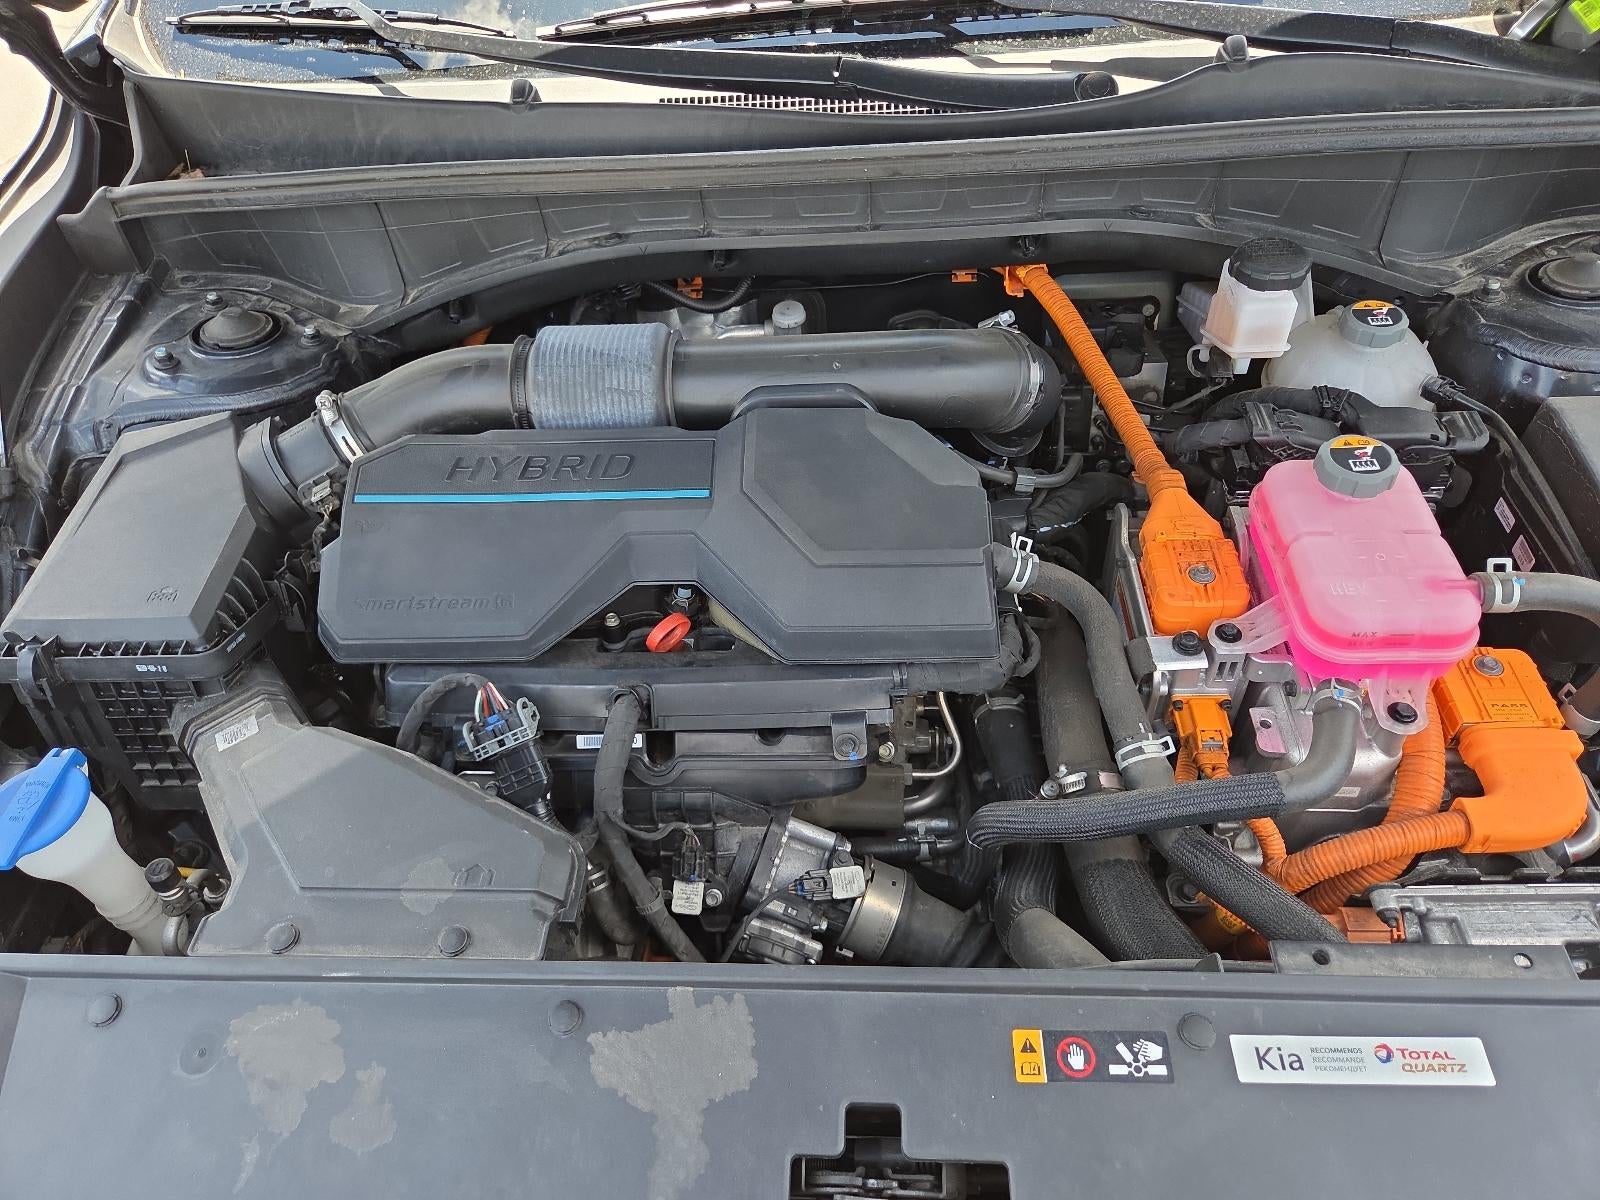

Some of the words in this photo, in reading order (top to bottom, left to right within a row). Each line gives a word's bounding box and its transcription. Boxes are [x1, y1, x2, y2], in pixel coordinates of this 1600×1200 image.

[444, 454, 634, 482] HYBRID
[1310, 1047, 1363, 1055] RECOMMENDS
[1395, 1047, 1456, 1060] TOTAL
[1254, 1046, 1305, 1071] Kia
[1312, 1056, 1367, 1064] RECOMMANDE
[1401, 1063, 1467, 1074] QUARTZ
